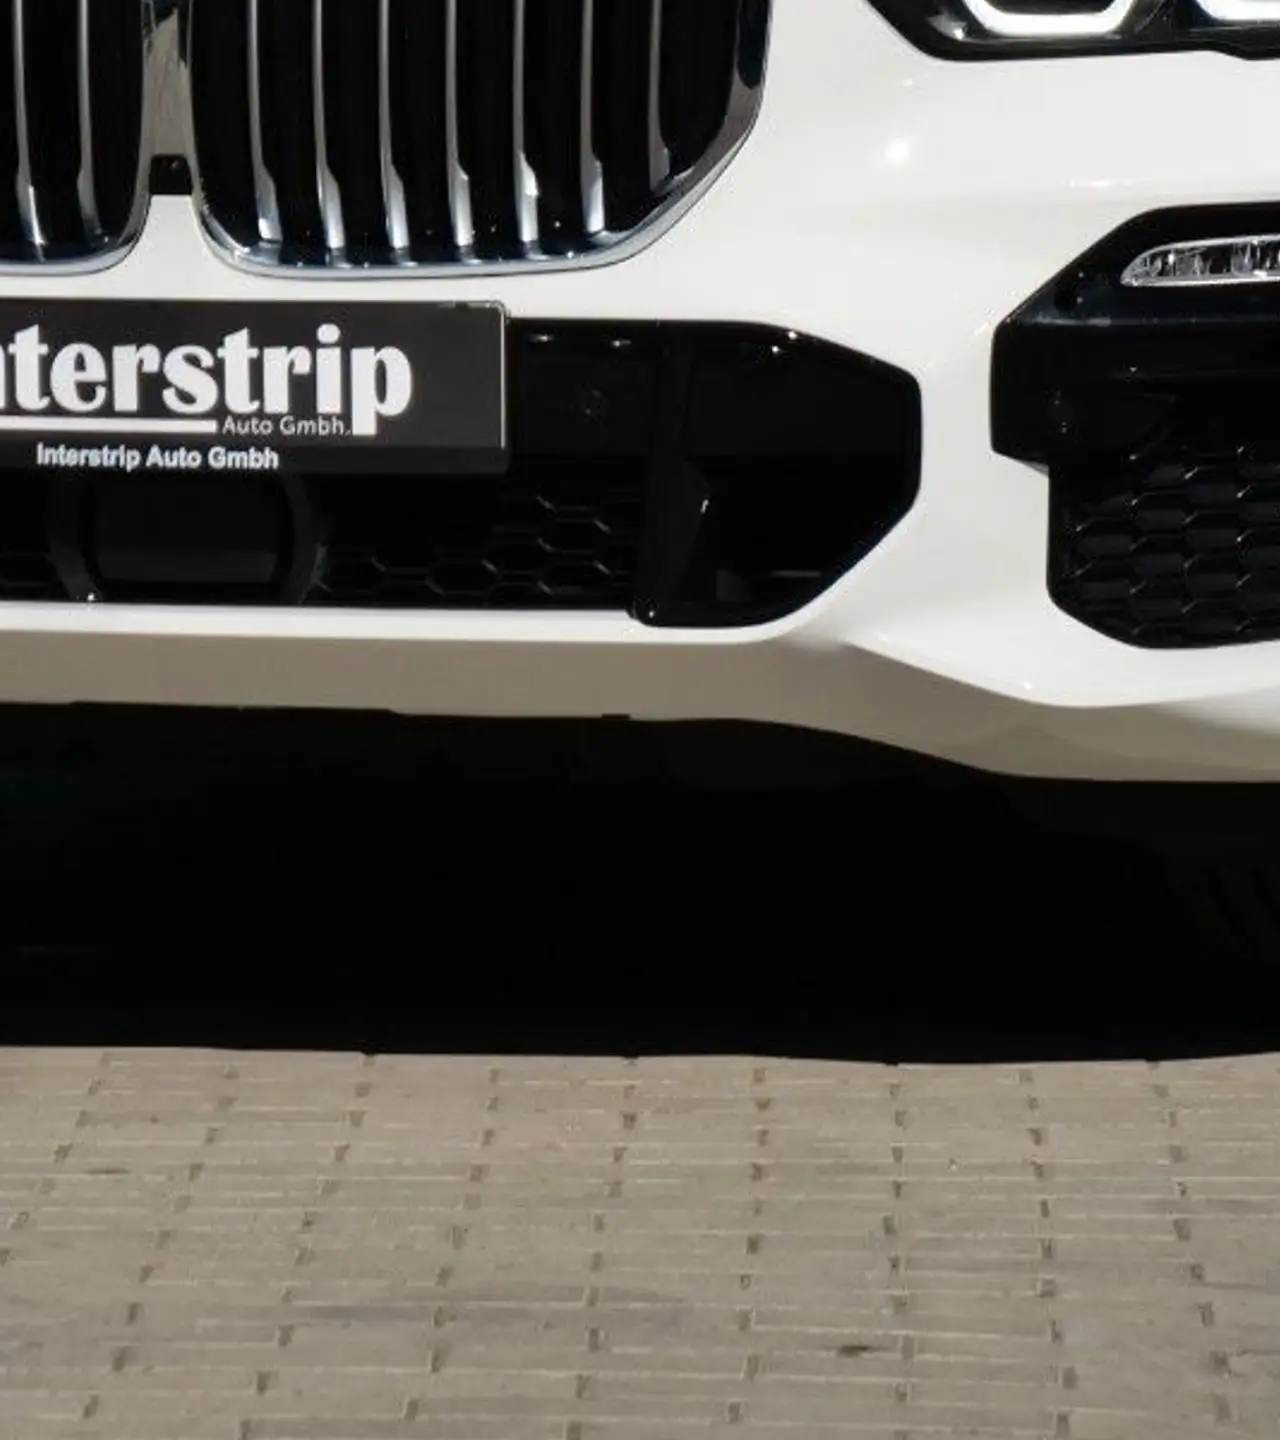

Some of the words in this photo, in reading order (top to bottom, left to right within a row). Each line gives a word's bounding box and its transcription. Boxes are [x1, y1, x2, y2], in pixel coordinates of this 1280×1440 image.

[222, 415, 274, 435] Auto
[36, 442, 142, 472] Interstrip
[145, 444, 203, 469] Auto
[207, 445, 279, 470] Gmbh
